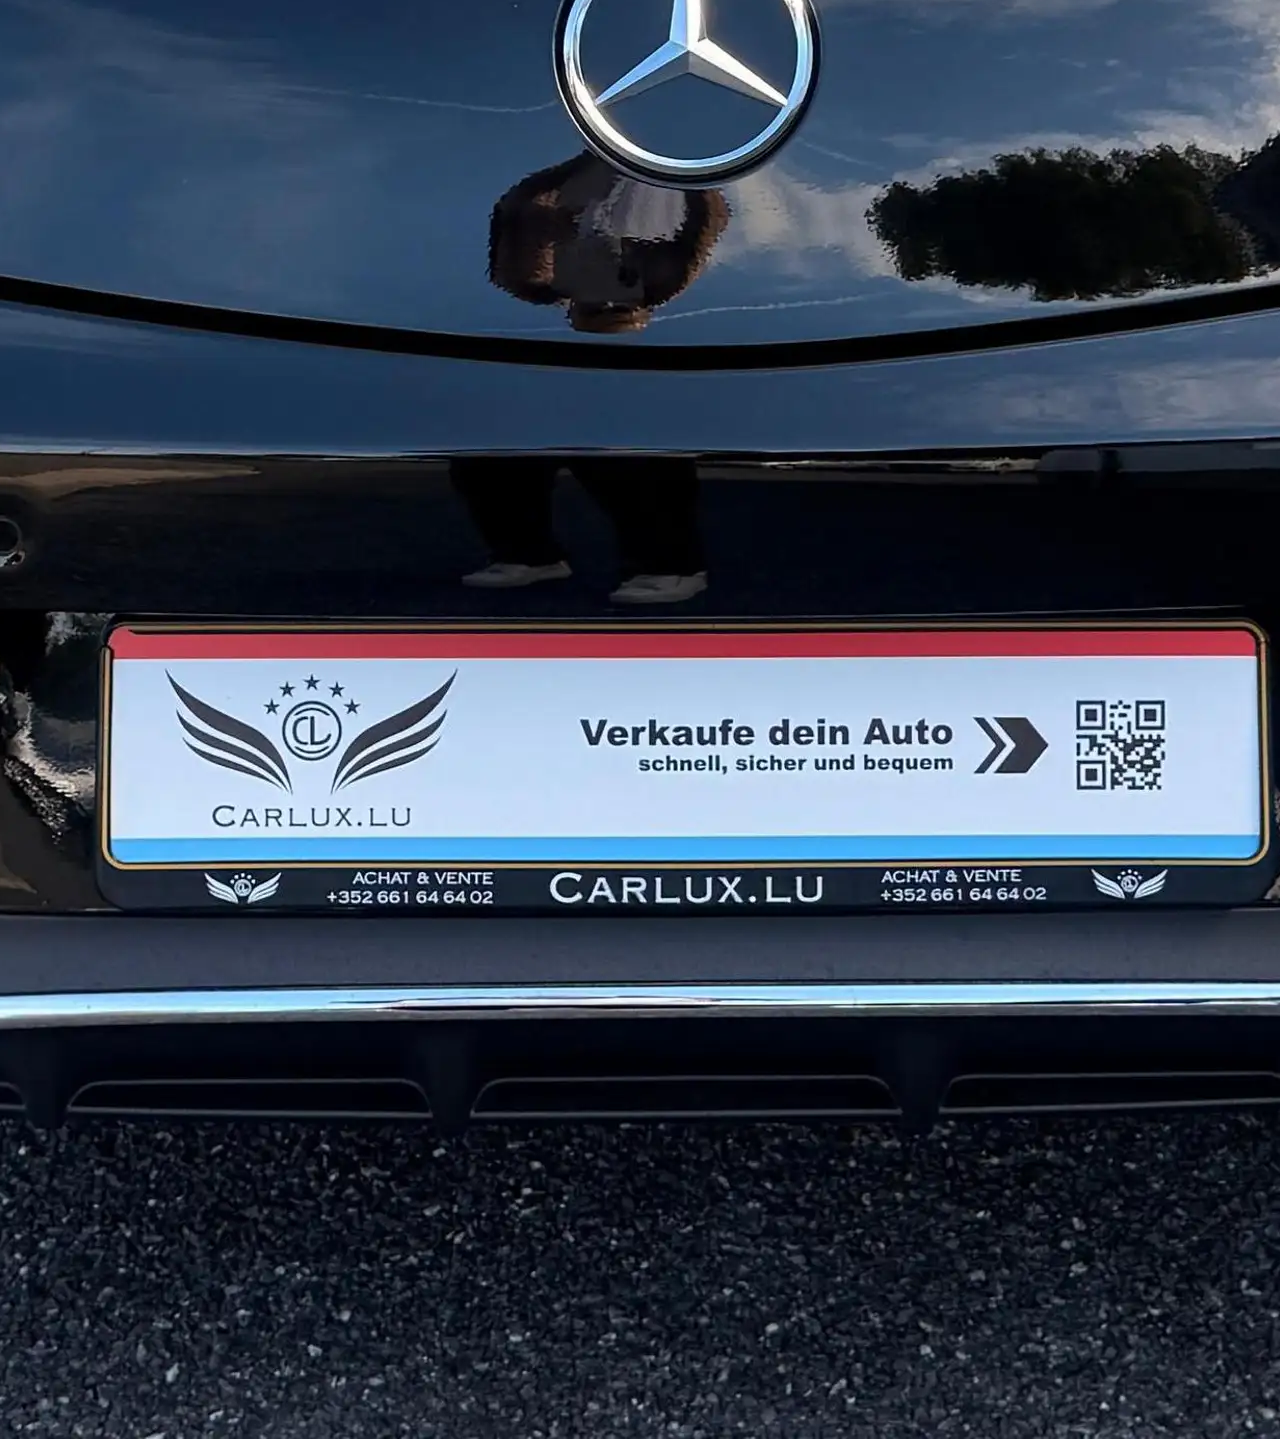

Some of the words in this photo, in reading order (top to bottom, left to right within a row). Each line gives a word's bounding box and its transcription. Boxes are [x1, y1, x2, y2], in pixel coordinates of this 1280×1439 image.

[579, 718, 755, 747] Verkaufe
[768, 718, 850, 746] dein
[863, 717, 953, 745] Auto
[638, 754, 728, 775] schnell,
[735, 754, 808, 772] sicher
[814, 753, 855, 771] und
[863, 753, 954, 775] bequem
[211, 804, 411, 828] CARLUX.LU
[352, 871, 412, 885] ACHAT
[416, 871, 430, 885] &
[434, 871, 494, 885] VENTE
[881, 869, 941, 884] ACHAT
[945, 869, 958, 883] &
[962, 869, 1022, 883] VENTE
[549, 871, 823, 904] CARLUX.LU
[880, 888, 927, 902] +352
[930, 887, 963, 902] 661
[969, 887, 993, 901] 64
[996, 887, 1020, 901] 64
[1022, 886, 1047, 901] 02
[326, 890, 373, 904] +352
[376, 890, 409, 904] 661
[415, 890, 439, 904] 64
[442, 890, 467, 904] 64
[469, 890, 494, 905] 02
